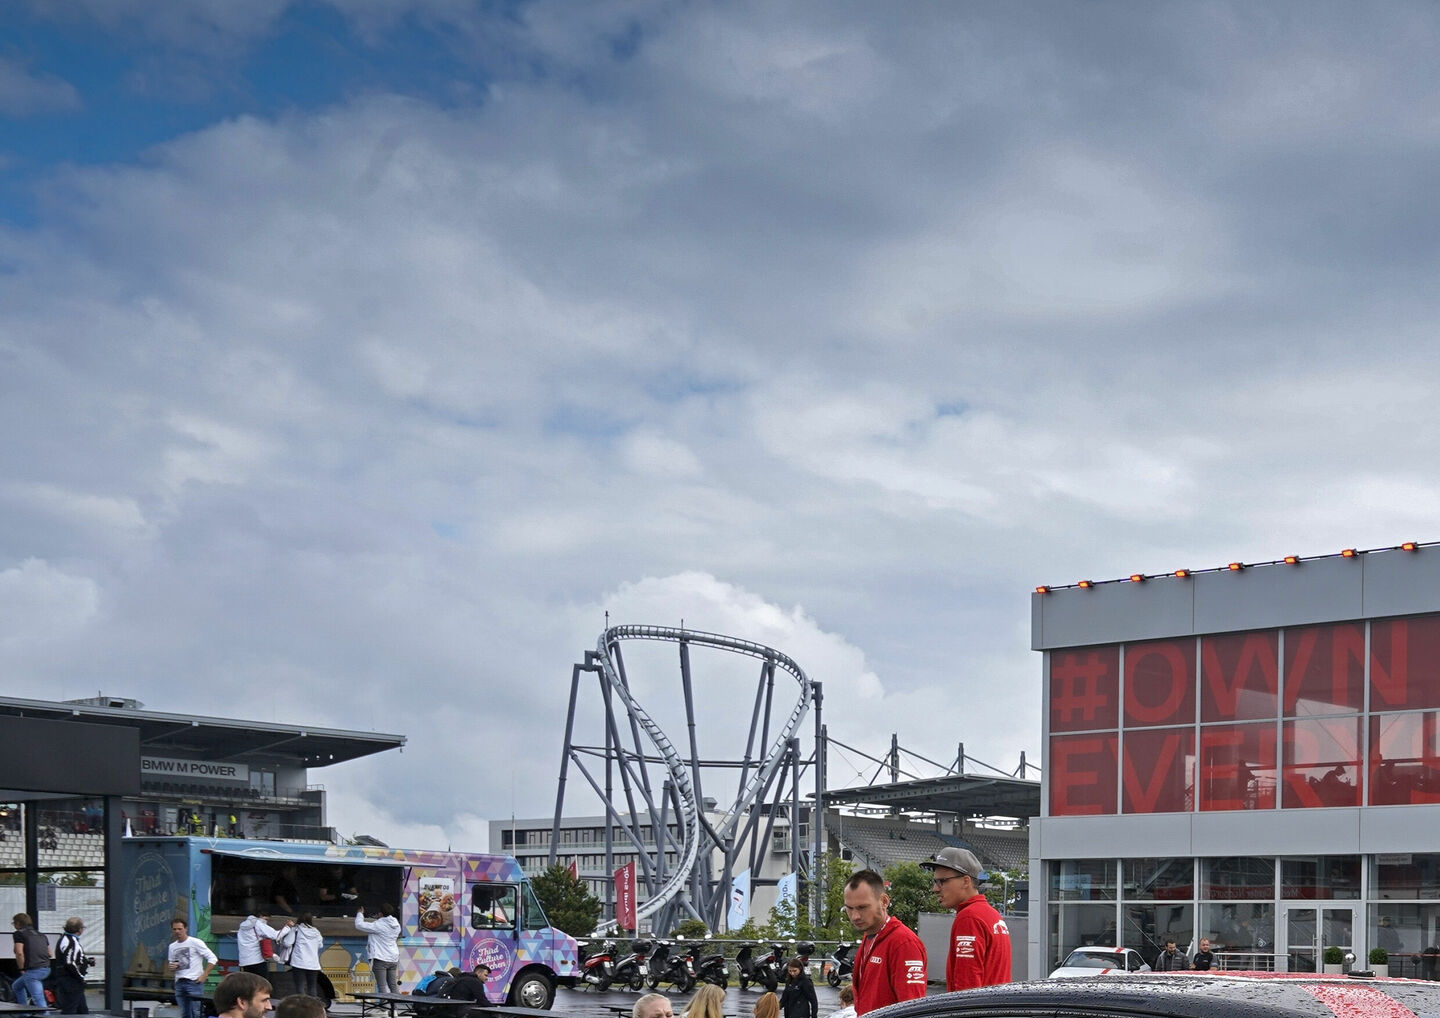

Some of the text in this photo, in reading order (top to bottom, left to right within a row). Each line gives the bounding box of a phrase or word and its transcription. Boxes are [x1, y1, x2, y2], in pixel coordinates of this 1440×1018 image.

[1050, 620, 1407, 722] #OWN
[142, 760, 236, 777] BMW M POWER
[478, 945, 499, 957] Third
[476, 954, 504, 965] Culture
